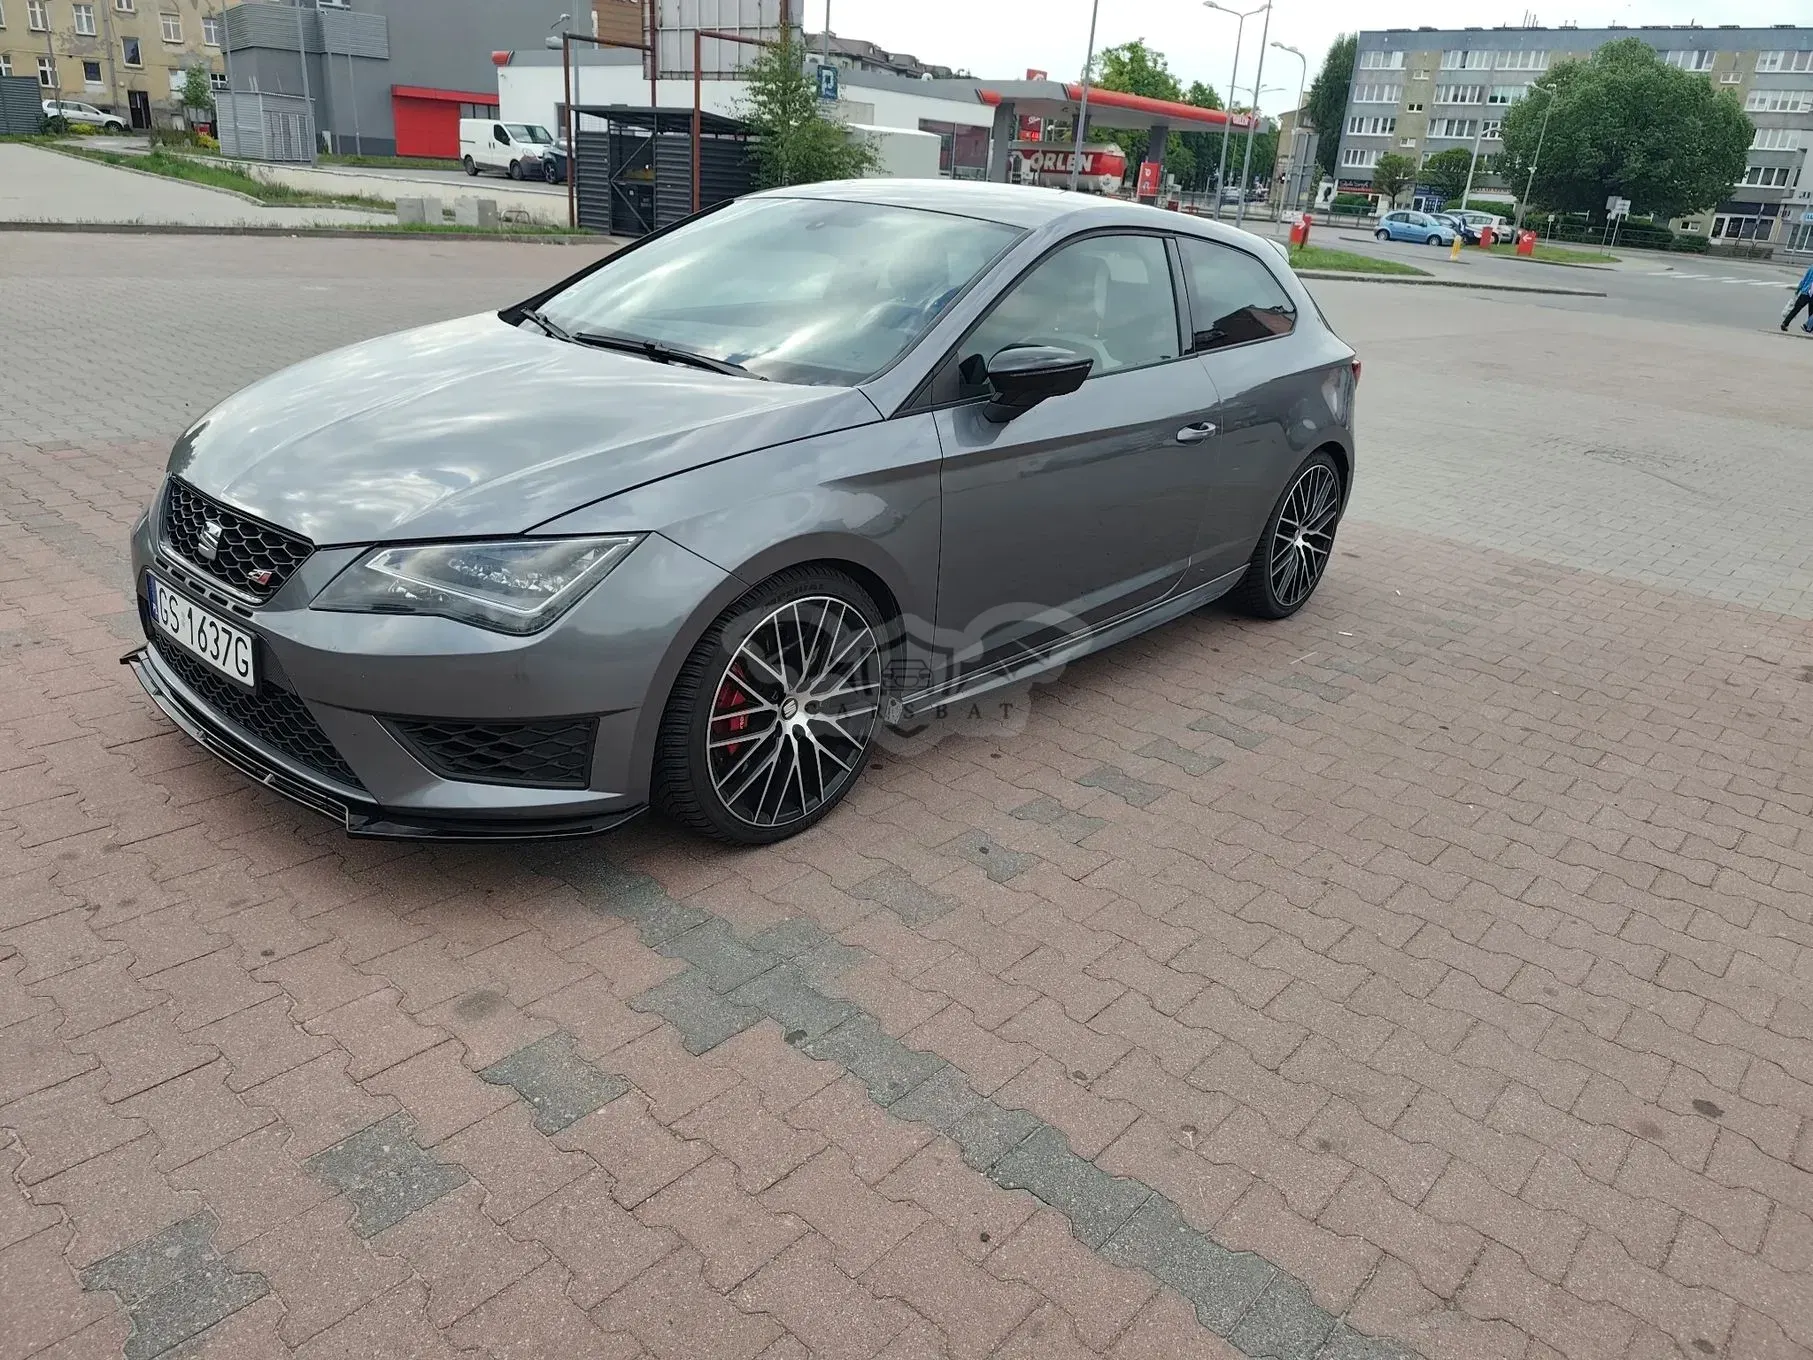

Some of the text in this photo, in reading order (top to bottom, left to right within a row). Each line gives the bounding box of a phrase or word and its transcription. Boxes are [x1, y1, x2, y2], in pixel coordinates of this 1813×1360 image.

[1030, 152, 1094, 172] ORLEN
[160, 588, 249, 677] GS 1637G
